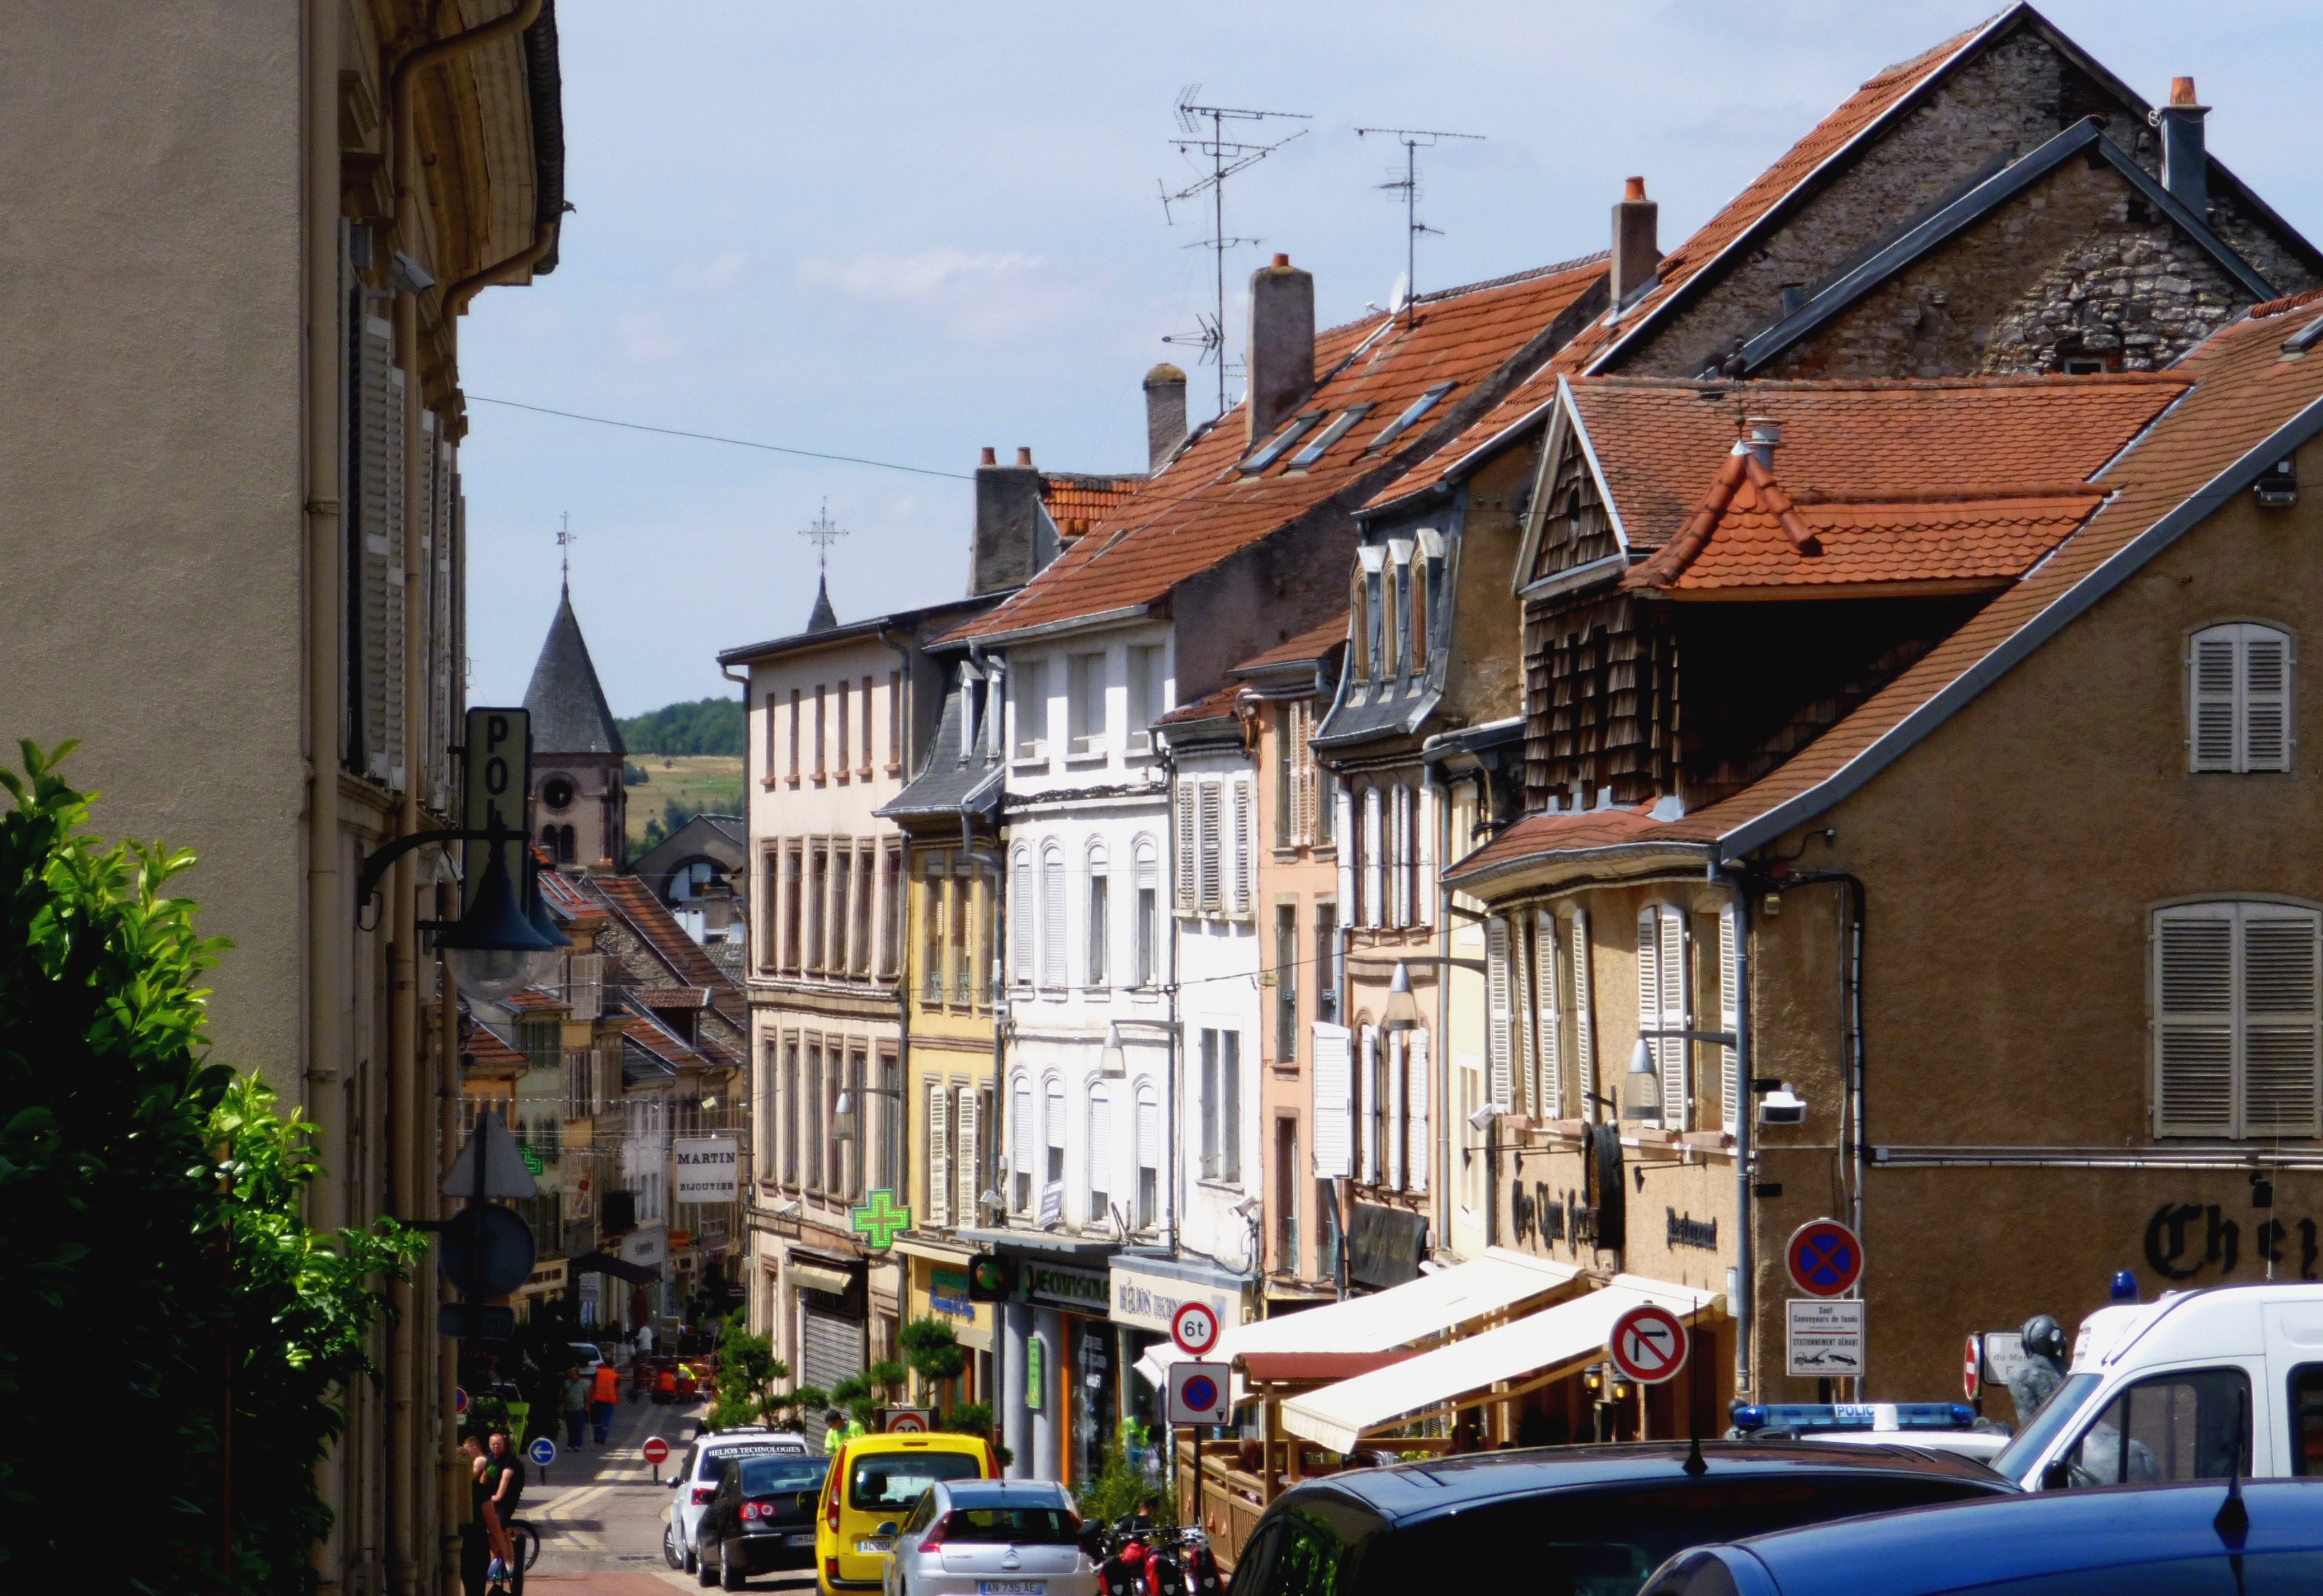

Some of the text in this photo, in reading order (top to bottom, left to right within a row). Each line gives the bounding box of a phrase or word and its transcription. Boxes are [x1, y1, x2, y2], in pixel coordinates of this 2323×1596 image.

[677, 1153, 735, 1164] MARTIN
[680, 1182, 733, 1191] BIJOUTIER
[1793, 1315, 1829, 1324] Convoyeurs
[1838, 1337, 1858, 1346] GÊNANT
[1836, 1405, 1874, 1416] POLIC
[709, 1447, 738, 1457] HELIOS
[986, 1583, 1036, 1593] AN 735 AE
